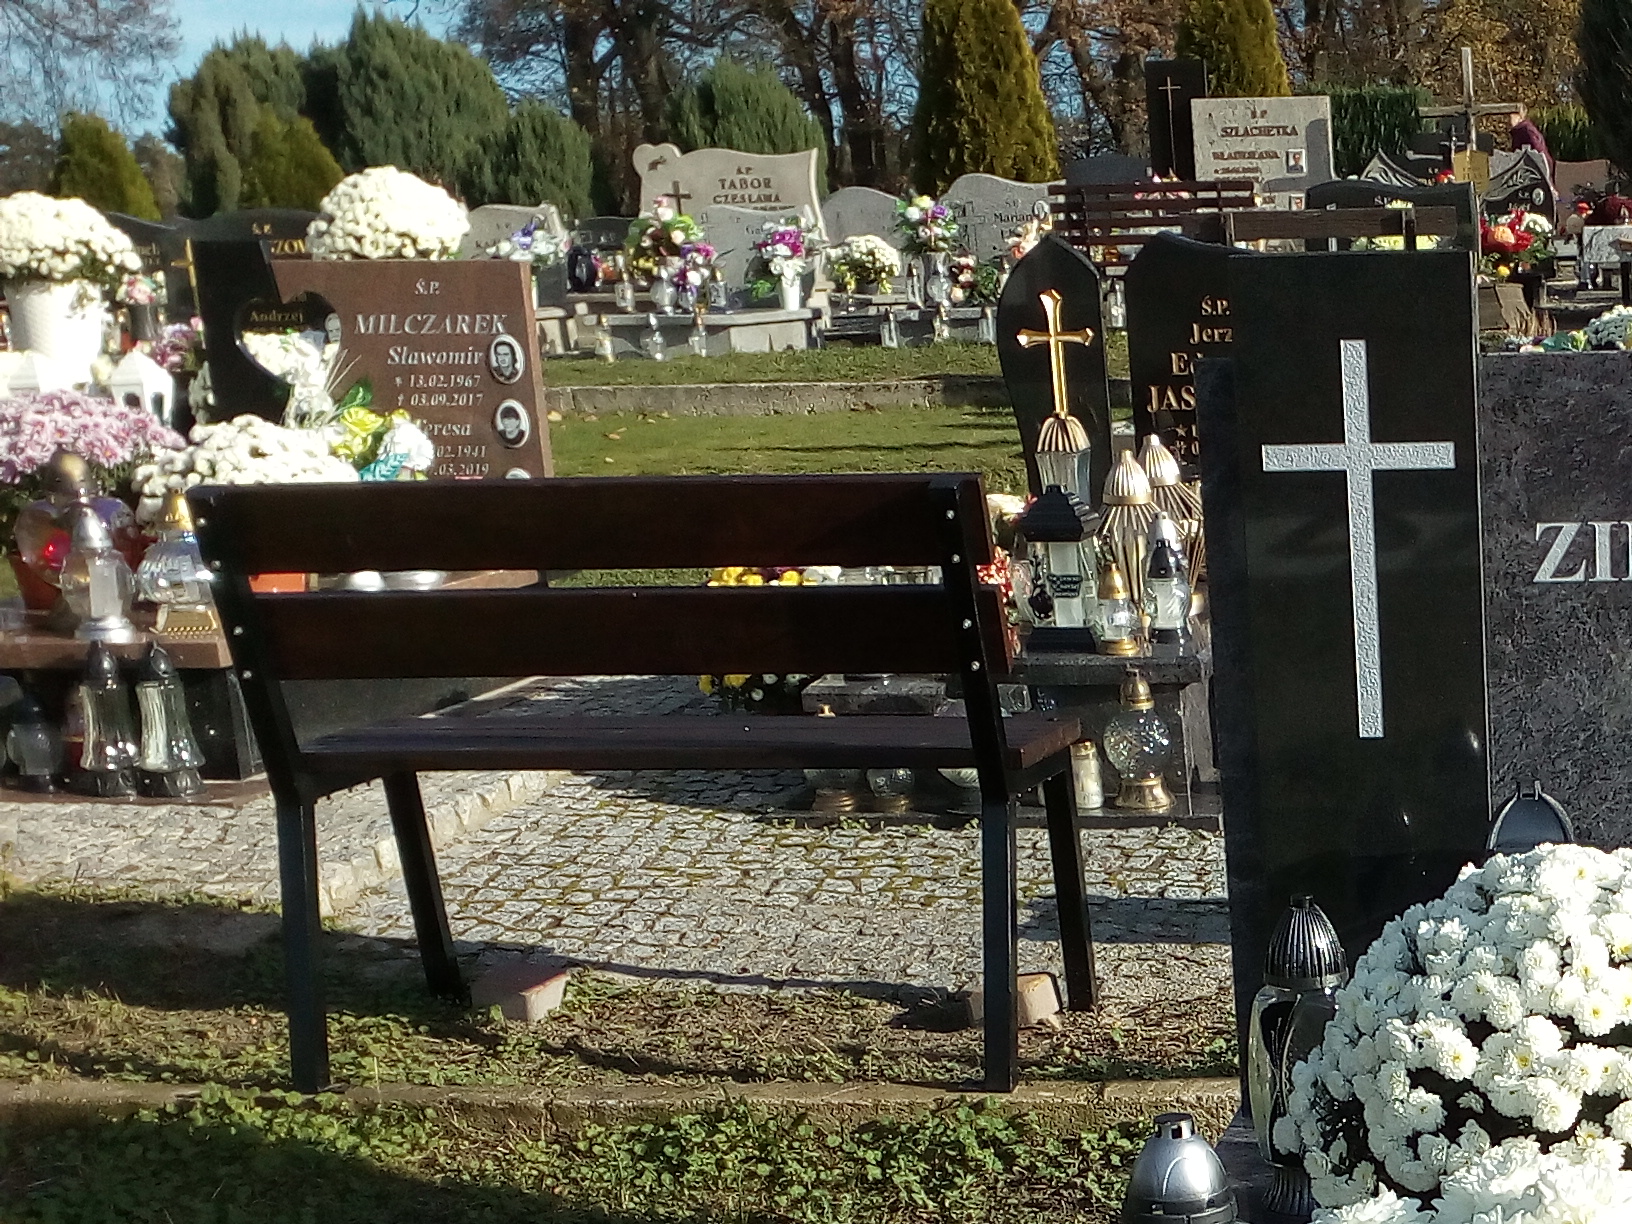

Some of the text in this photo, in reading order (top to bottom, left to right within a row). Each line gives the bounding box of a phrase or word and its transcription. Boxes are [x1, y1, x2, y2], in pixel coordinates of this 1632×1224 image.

[1201, 295, 1231, 316] Ś.P.
[250, 310, 303, 323] Andrzej
[354, 313, 508, 334] MILCZAREK
[409, 374, 481, 388] 13.02.1967
[410, 393, 484, 407] 03.09.2017
